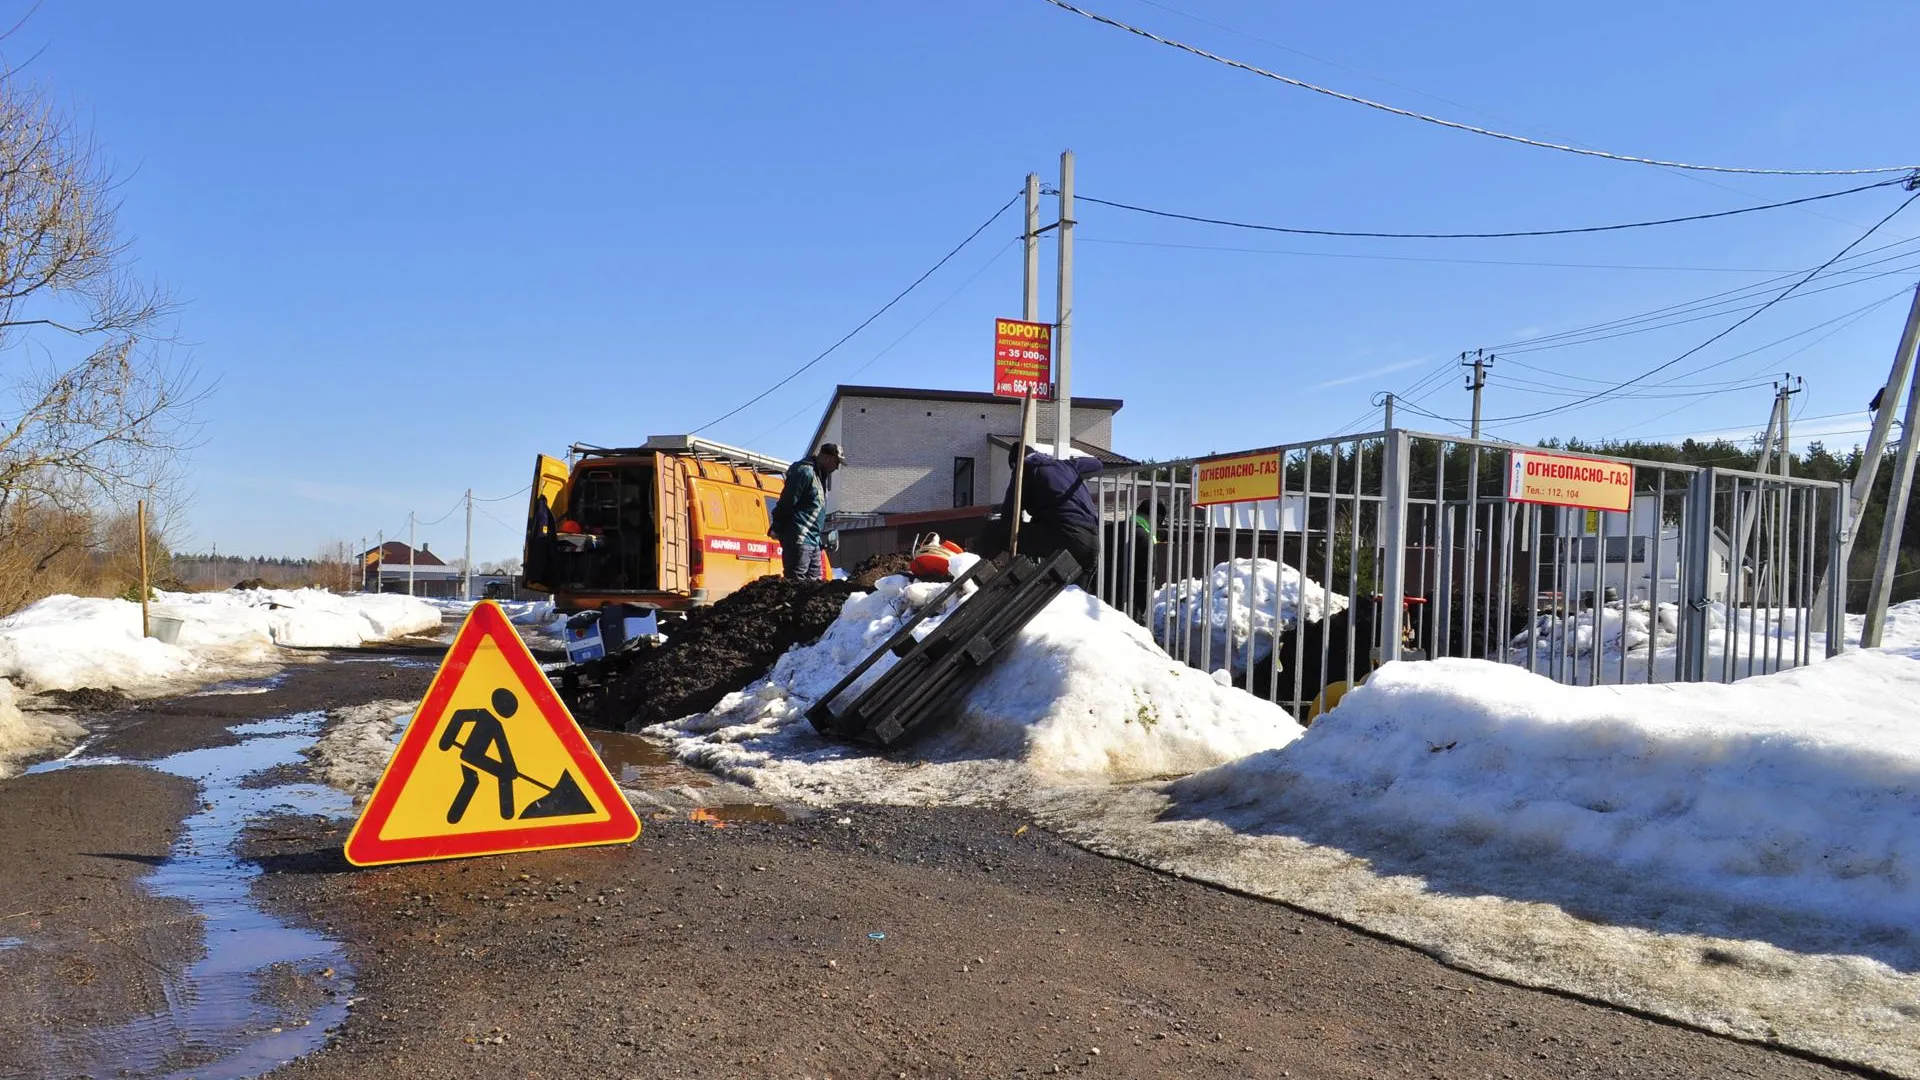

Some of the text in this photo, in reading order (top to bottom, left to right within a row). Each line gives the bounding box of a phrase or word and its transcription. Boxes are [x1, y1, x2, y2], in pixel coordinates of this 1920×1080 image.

[998, 322, 1049, 339] ВОРОТА
[1008, 349, 1020, 357] 35
[1200, 460, 1277, 482] ОГНЕОПАСНО-ГАЗ
[1526, 461, 1628, 486] ОГНЕОПАСНО-ГАЗ
[1226, 487, 1236, 495] 104
[1526, 485, 1544, 495] Тел.:
[1566, 490, 1579, 498] 104
